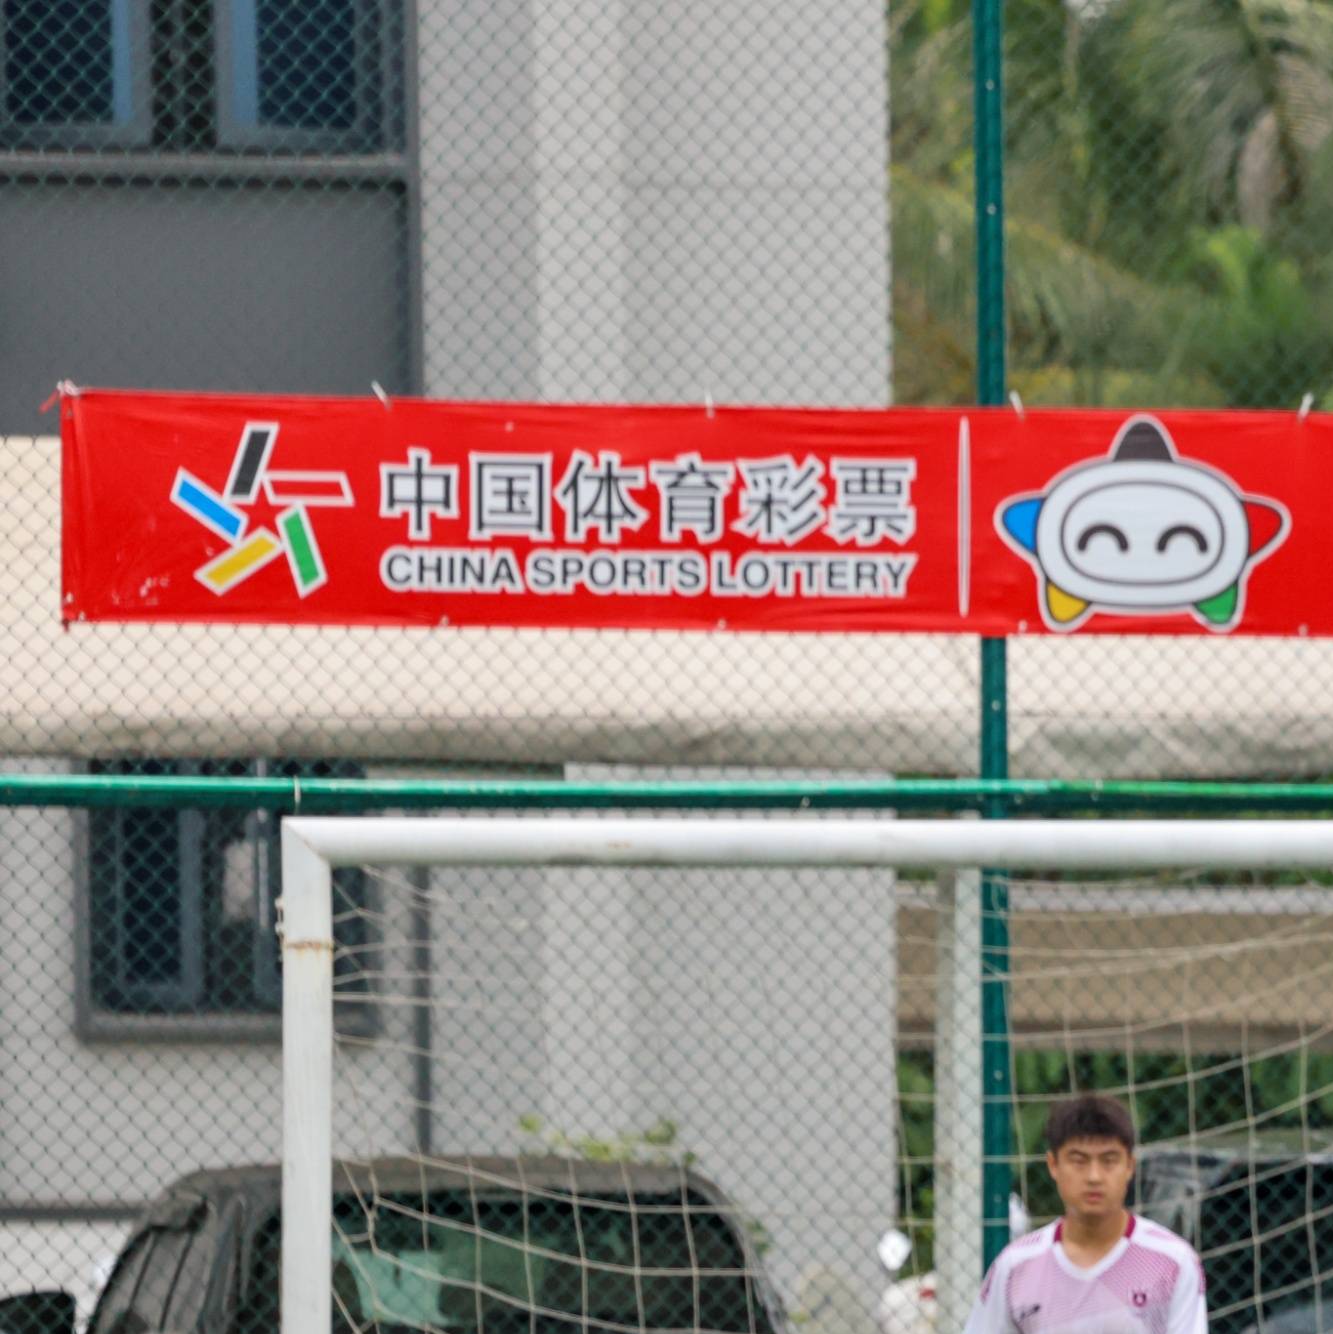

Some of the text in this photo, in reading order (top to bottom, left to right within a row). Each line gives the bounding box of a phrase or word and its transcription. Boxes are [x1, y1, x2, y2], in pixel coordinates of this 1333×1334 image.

[379, 447, 916, 545] 中国体育彩票
[382, 548, 914, 596] CHINA SPORTS LOTTERY
